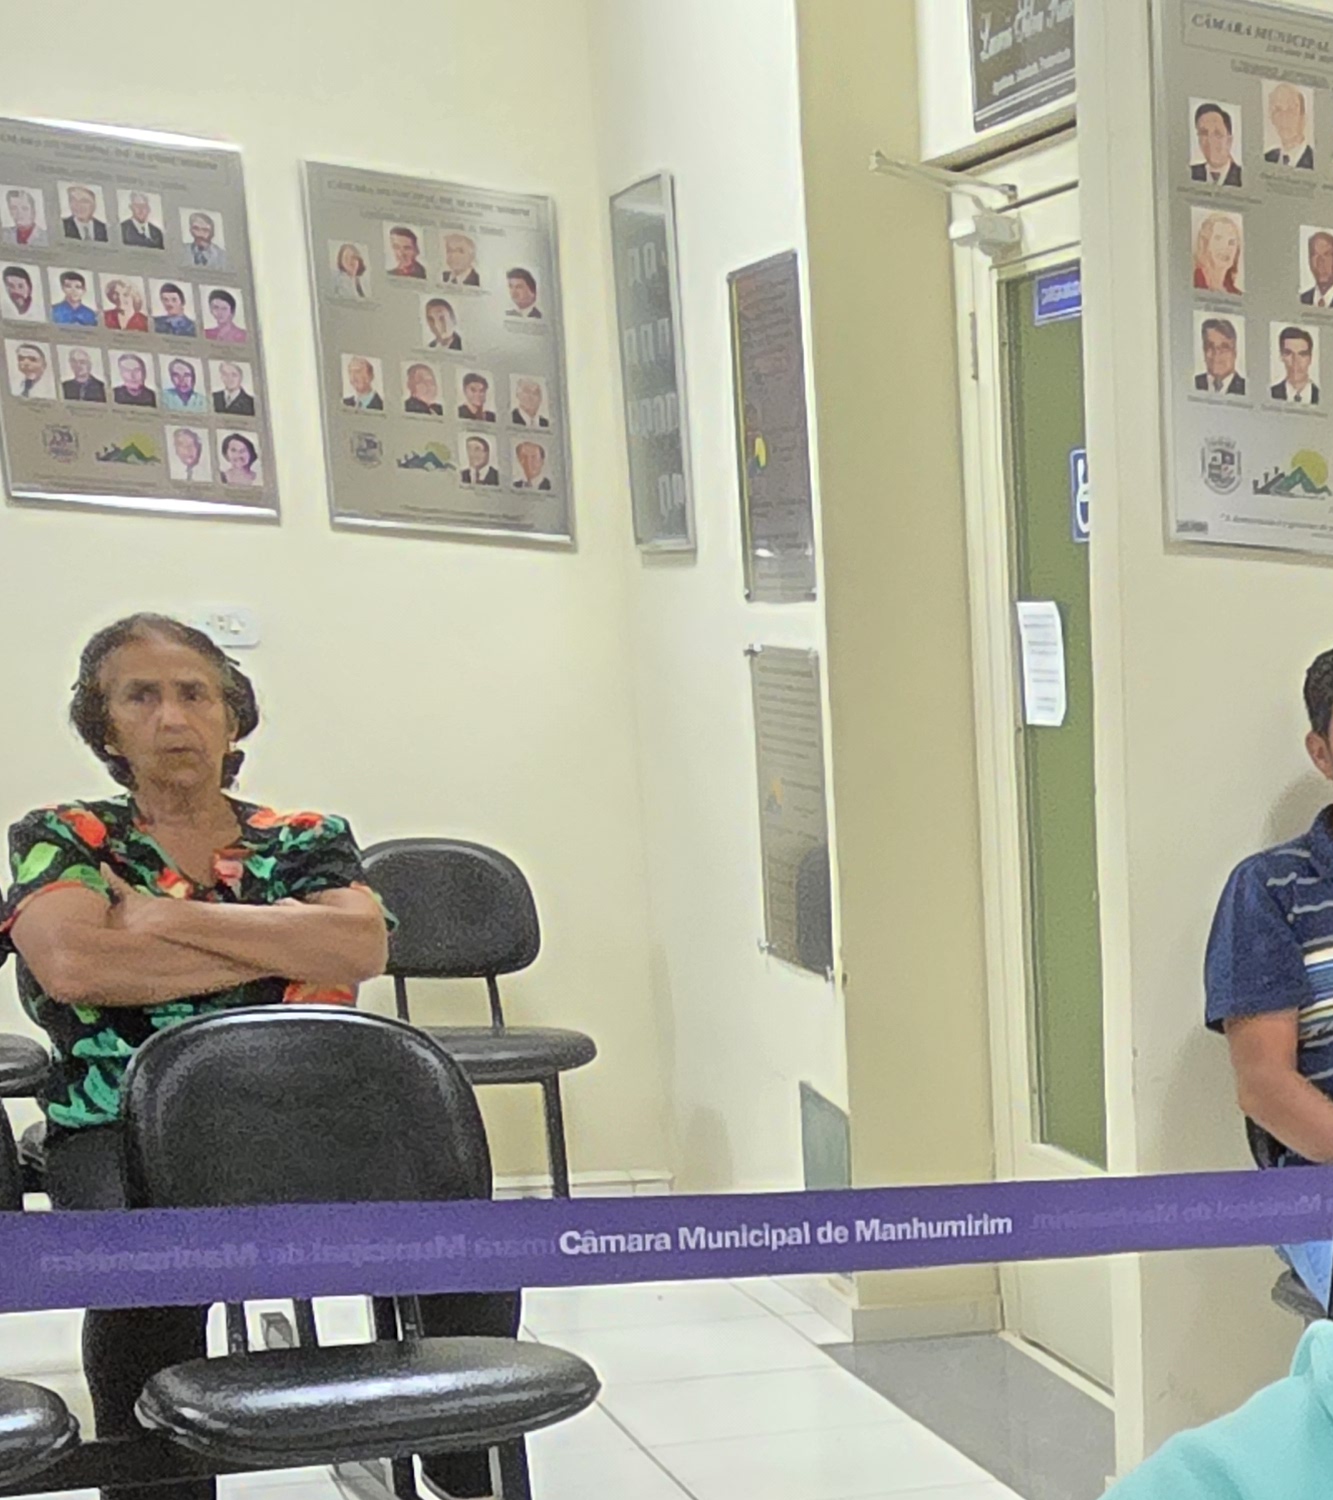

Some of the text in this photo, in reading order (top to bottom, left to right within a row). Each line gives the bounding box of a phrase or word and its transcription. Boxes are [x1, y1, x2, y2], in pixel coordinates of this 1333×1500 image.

[559, 1212, 1013, 1255] Câmara Municipal de Manhumirim
